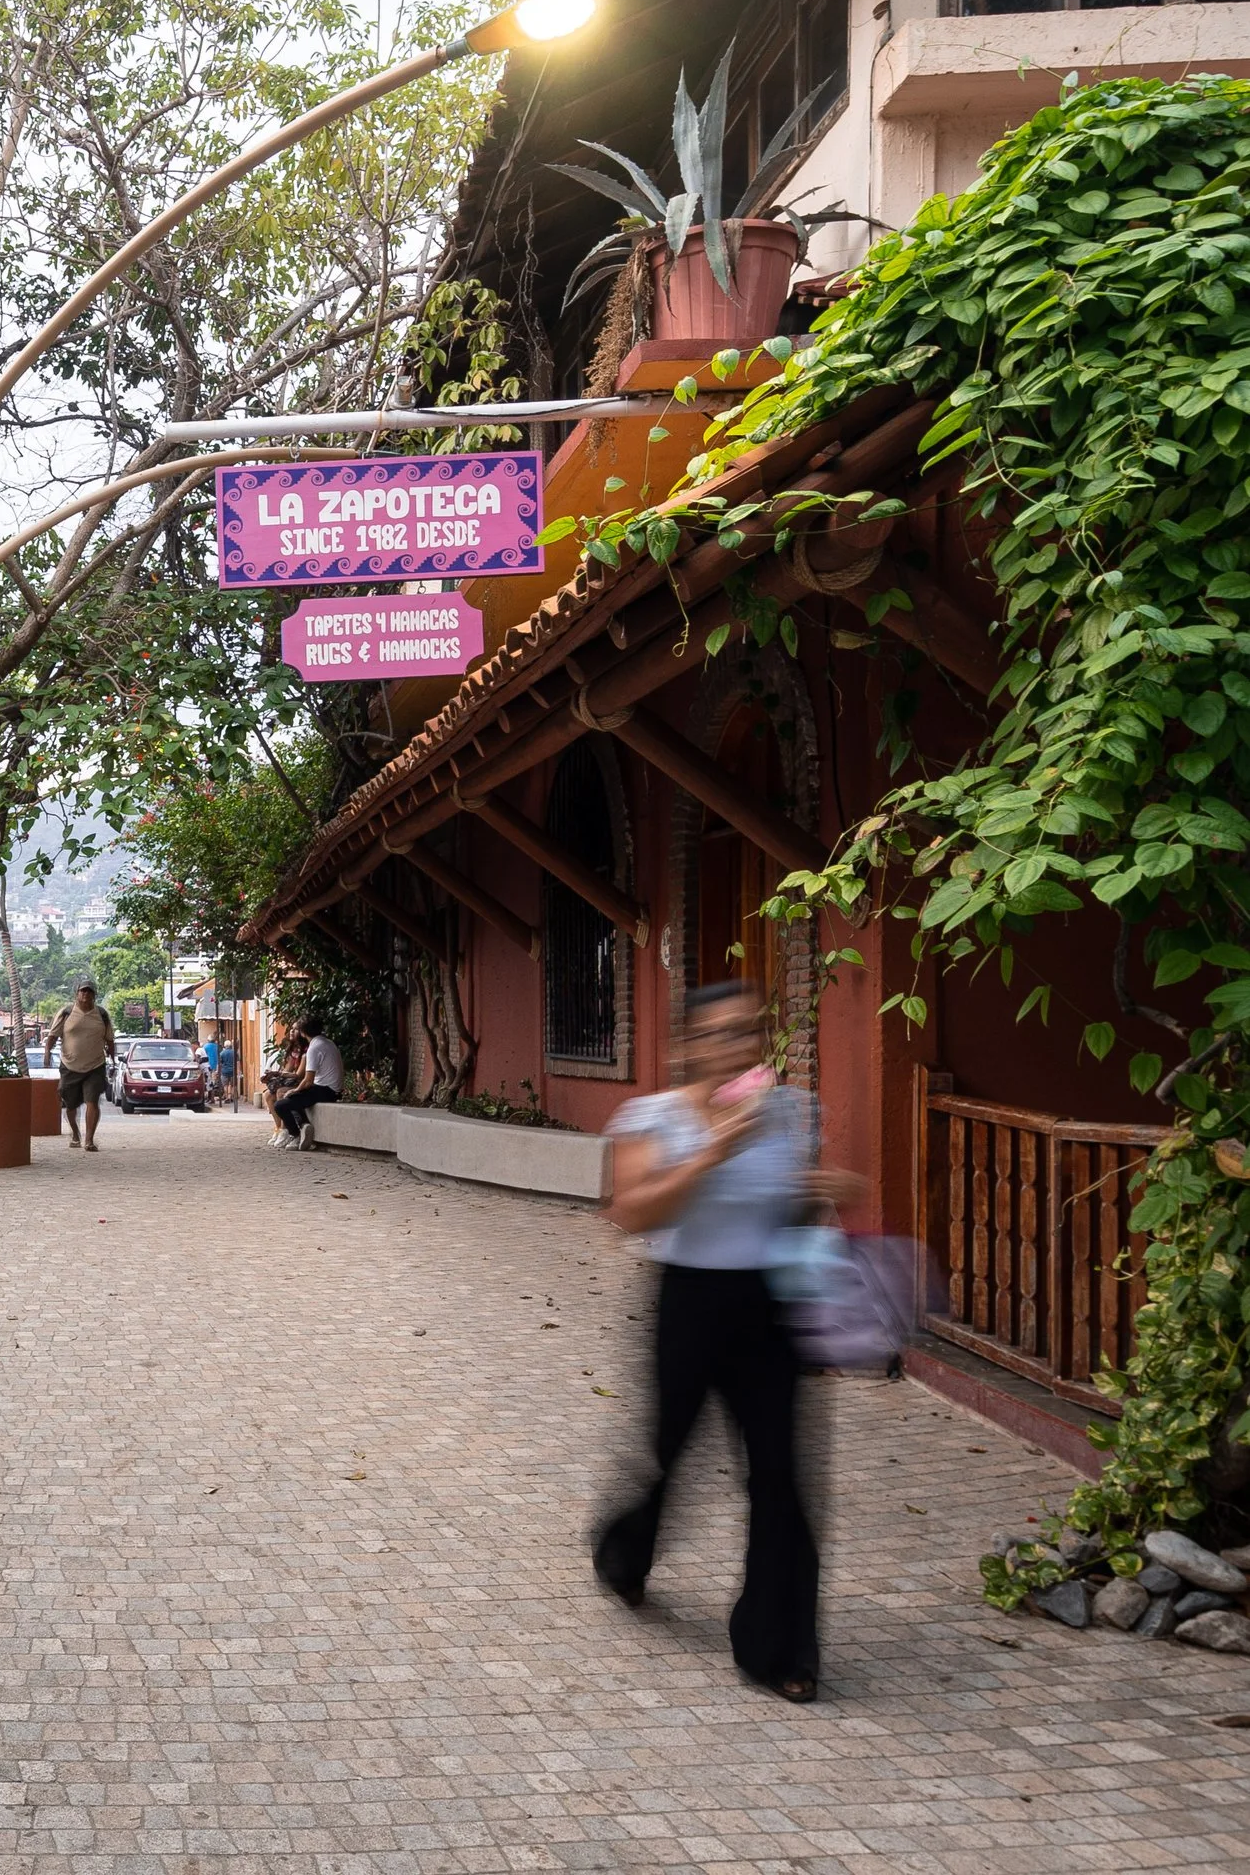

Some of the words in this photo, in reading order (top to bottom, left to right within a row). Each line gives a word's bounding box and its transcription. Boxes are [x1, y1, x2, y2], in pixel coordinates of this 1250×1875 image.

[258, 493, 304, 526] LA
[318, 484, 501, 523] ZAPOTECA
[280, 527, 344, 556] SINCE
[356, 523, 408, 552] 1982
[417, 519, 481, 547] DESDE
[305, 612, 373, 637] TAPETES
[390, 607, 460, 633] HAMACAS
[306, 641, 353, 666] RUGS
[358, 641, 371, 663] &
[379, 636, 461, 662] HAMMOCKS
